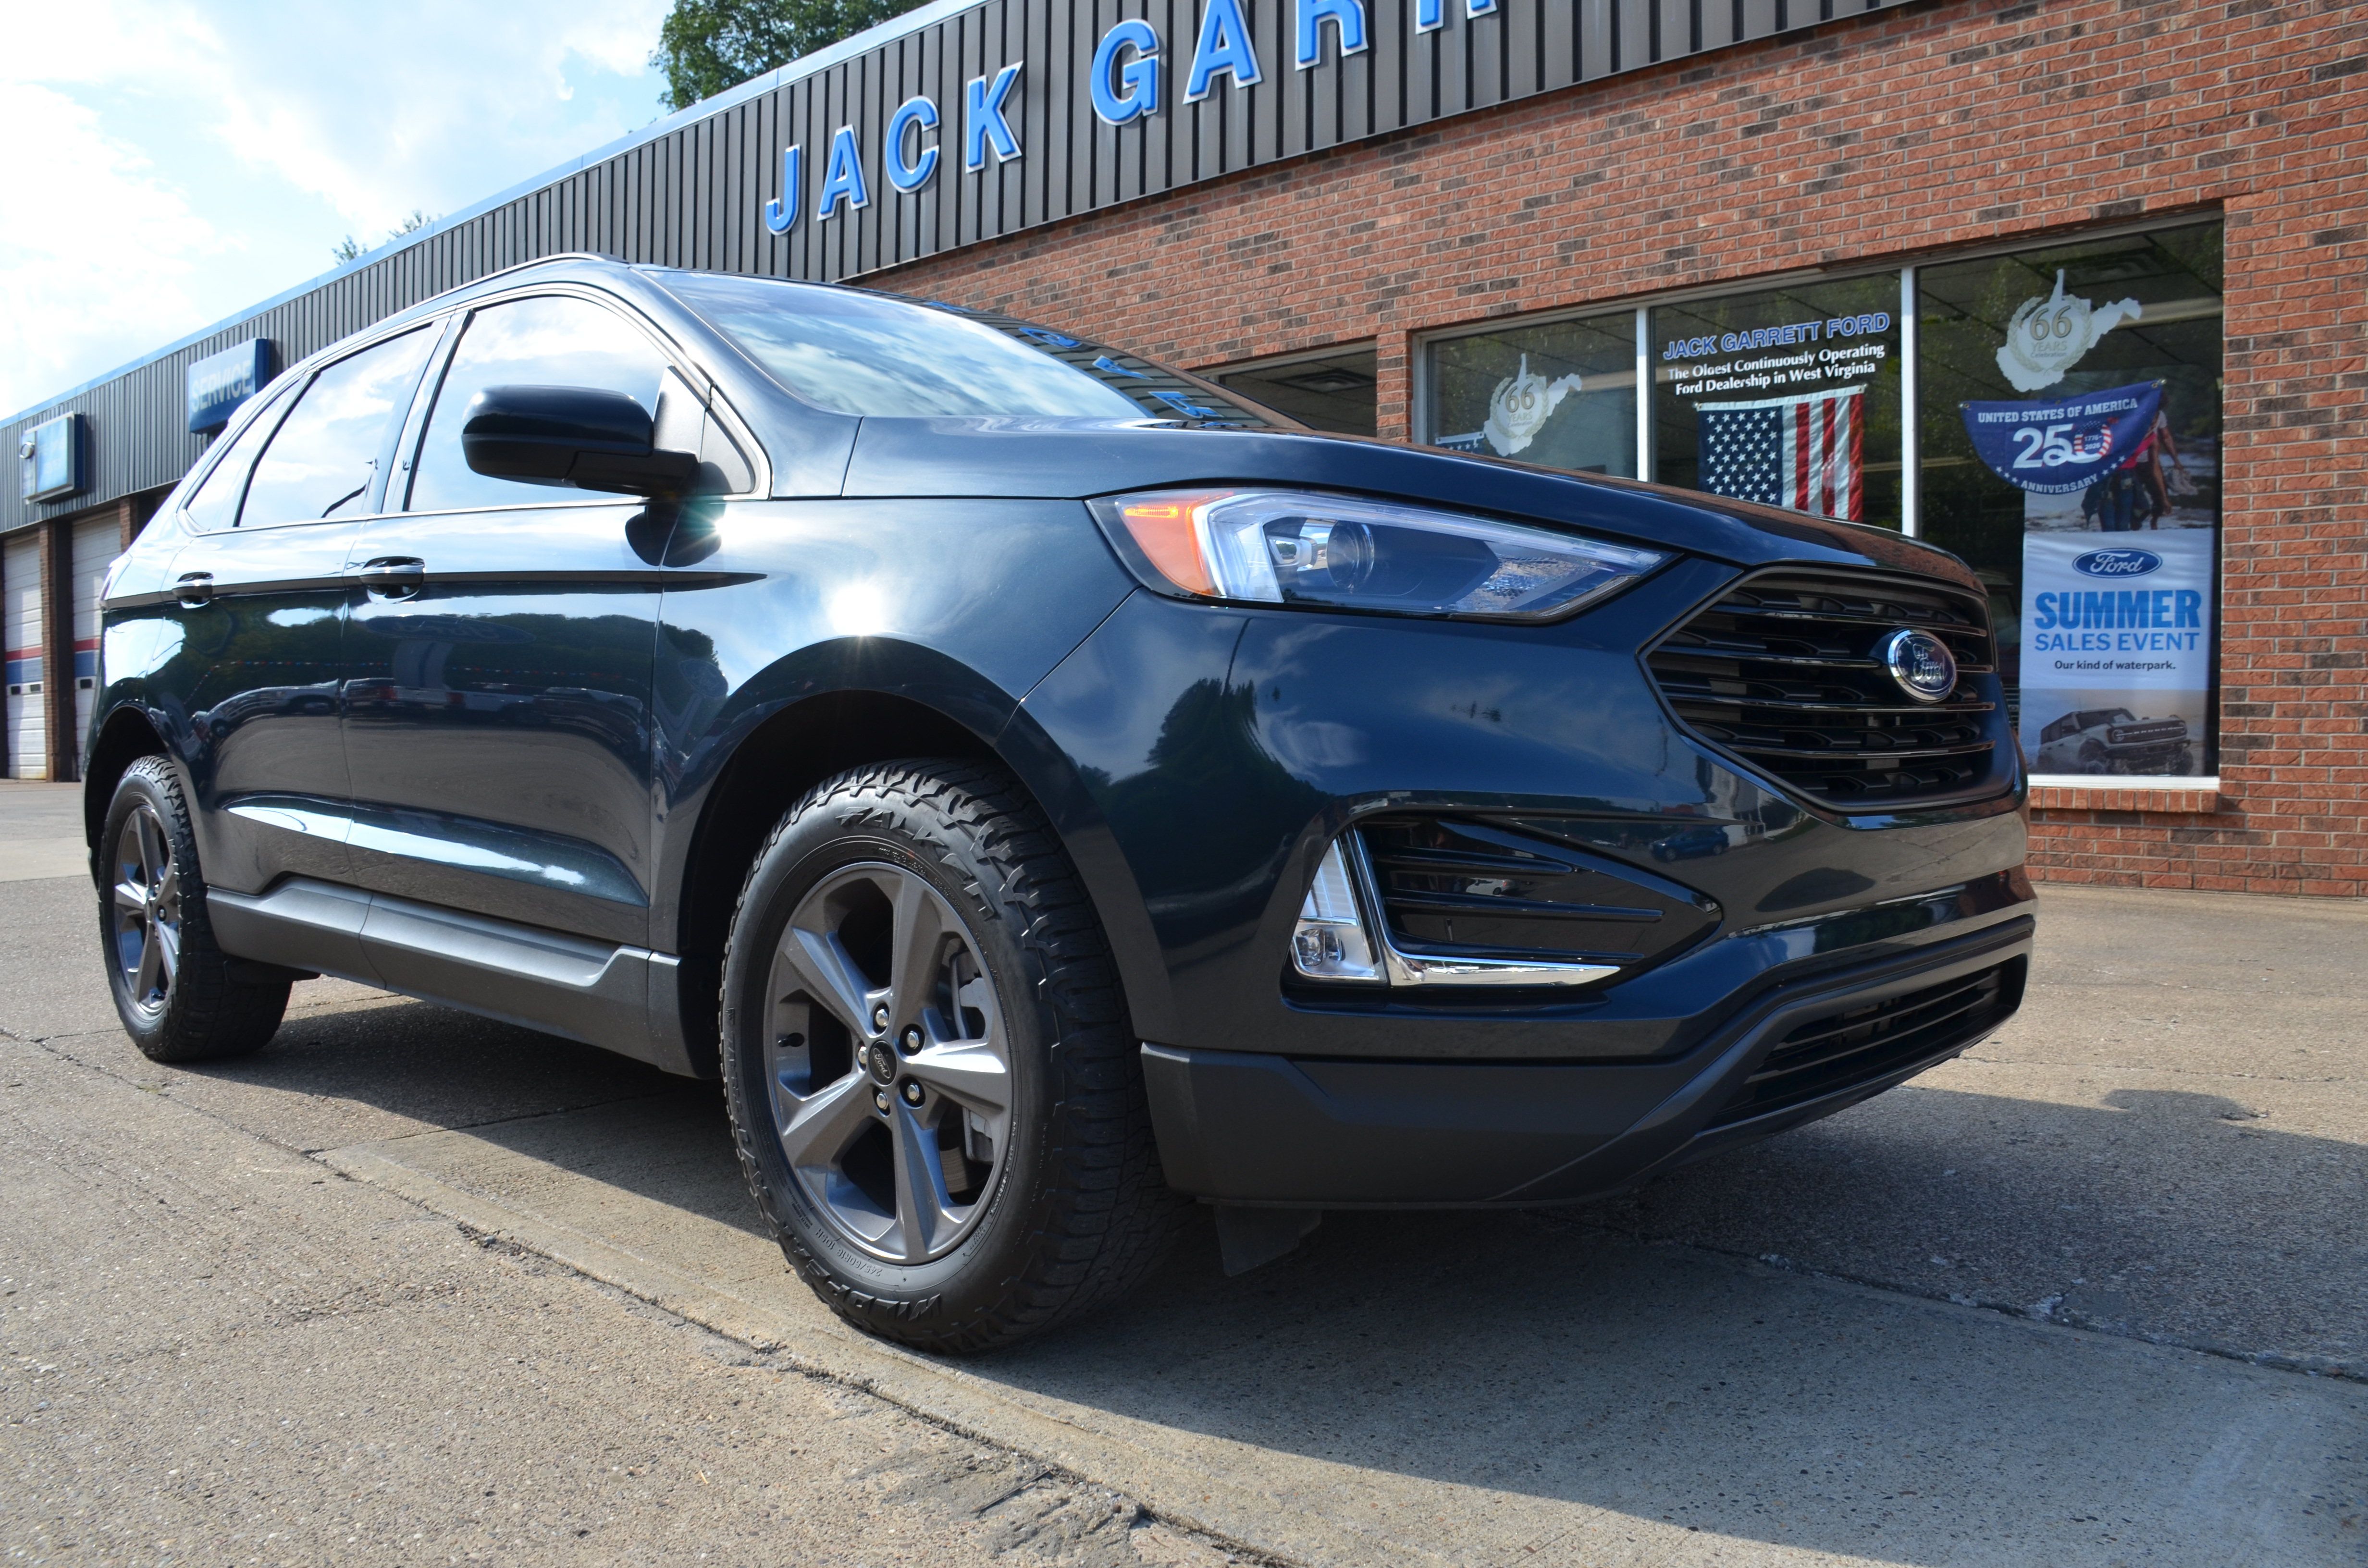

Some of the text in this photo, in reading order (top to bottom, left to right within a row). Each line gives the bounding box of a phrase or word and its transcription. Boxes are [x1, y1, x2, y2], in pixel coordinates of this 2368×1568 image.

[765, 61, 1023, 236] JACK
[1663, 312, 1890, 360] JACK GARRETT FORD
[2030, 305, 2072, 341] 66
[1668, 368, 1690, 380] The
[1734, 350, 1816, 372] Continuously
[1818, 343, 1886, 364] Operating
[2030, 341, 2067, 352] YEARS
[192, 359, 252, 413] SERVICE
[1676, 361, 1876, 395] Ford Dealership in West Virginia
[1505, 382, 1535, 413] 66
[1977, 398, 2138, 423] UNITED STATES OF AMERICA
[2012, 421, 2112, 469] 250
[2021, 473, 2098, 494] ANNIVERSARY
[2090, 552, 2144, 573] Ford
[2034, 589, 2202, 630] SUMMER
[2034, 632, 2200, 651] SALES EVENT
[1913, 643, 1948, 681] Ford
[2054, 660, 2176, 672] Our kind of waterpark.
